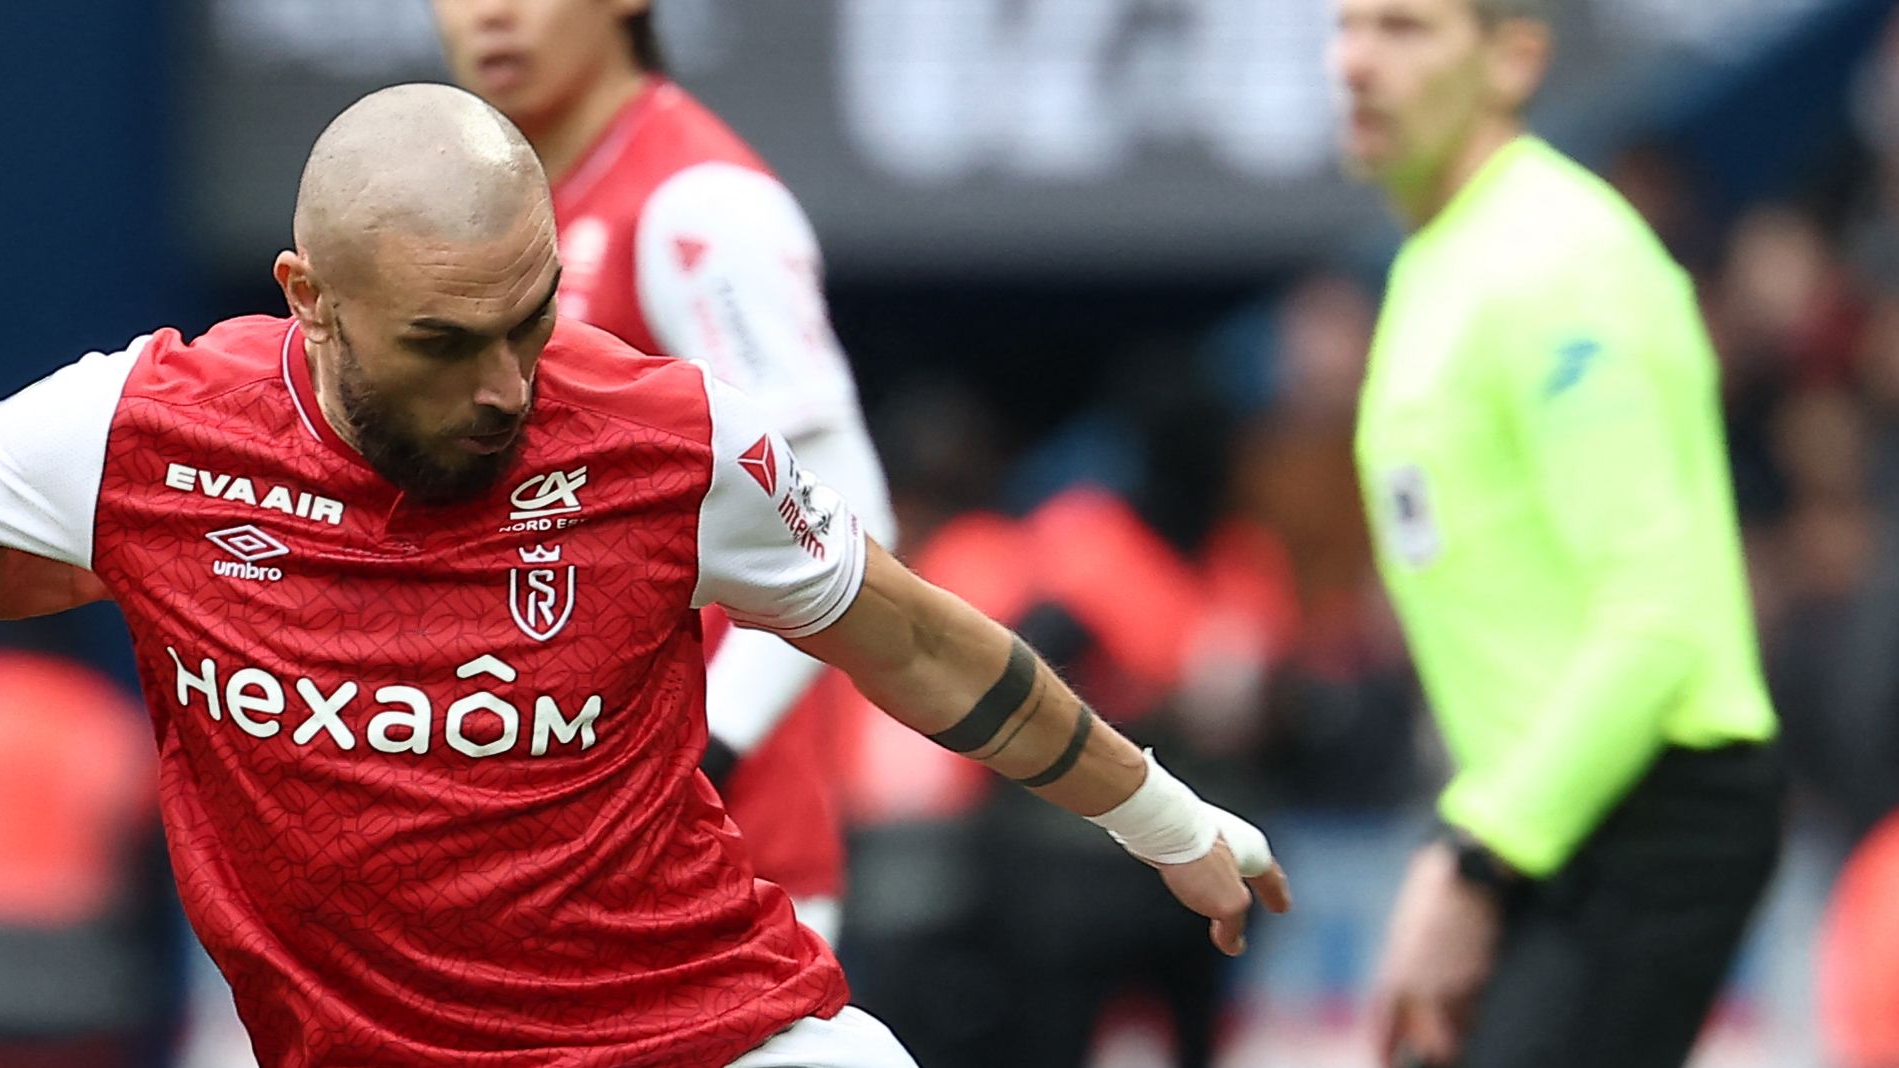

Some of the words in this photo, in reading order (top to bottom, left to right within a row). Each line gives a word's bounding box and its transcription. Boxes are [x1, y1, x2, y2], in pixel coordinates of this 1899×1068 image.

[165, 462, 257, 506] EVA
[260, 485, 344, 526] AIR
[212, 560, 283, 582] umbro
